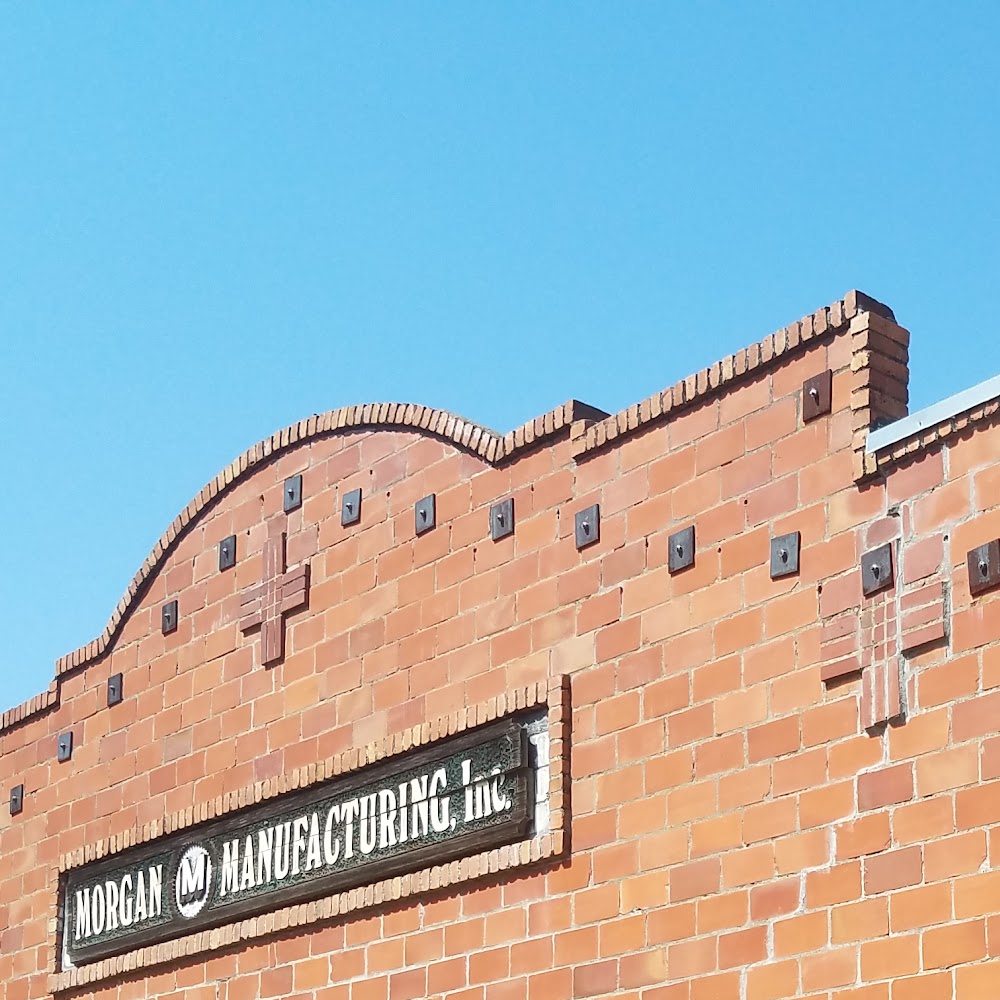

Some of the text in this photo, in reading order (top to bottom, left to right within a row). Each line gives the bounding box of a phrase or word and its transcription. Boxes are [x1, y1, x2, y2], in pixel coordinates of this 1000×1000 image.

[75, 758, 512, 941] MORGAN M MANUFACTURING, Inc.
